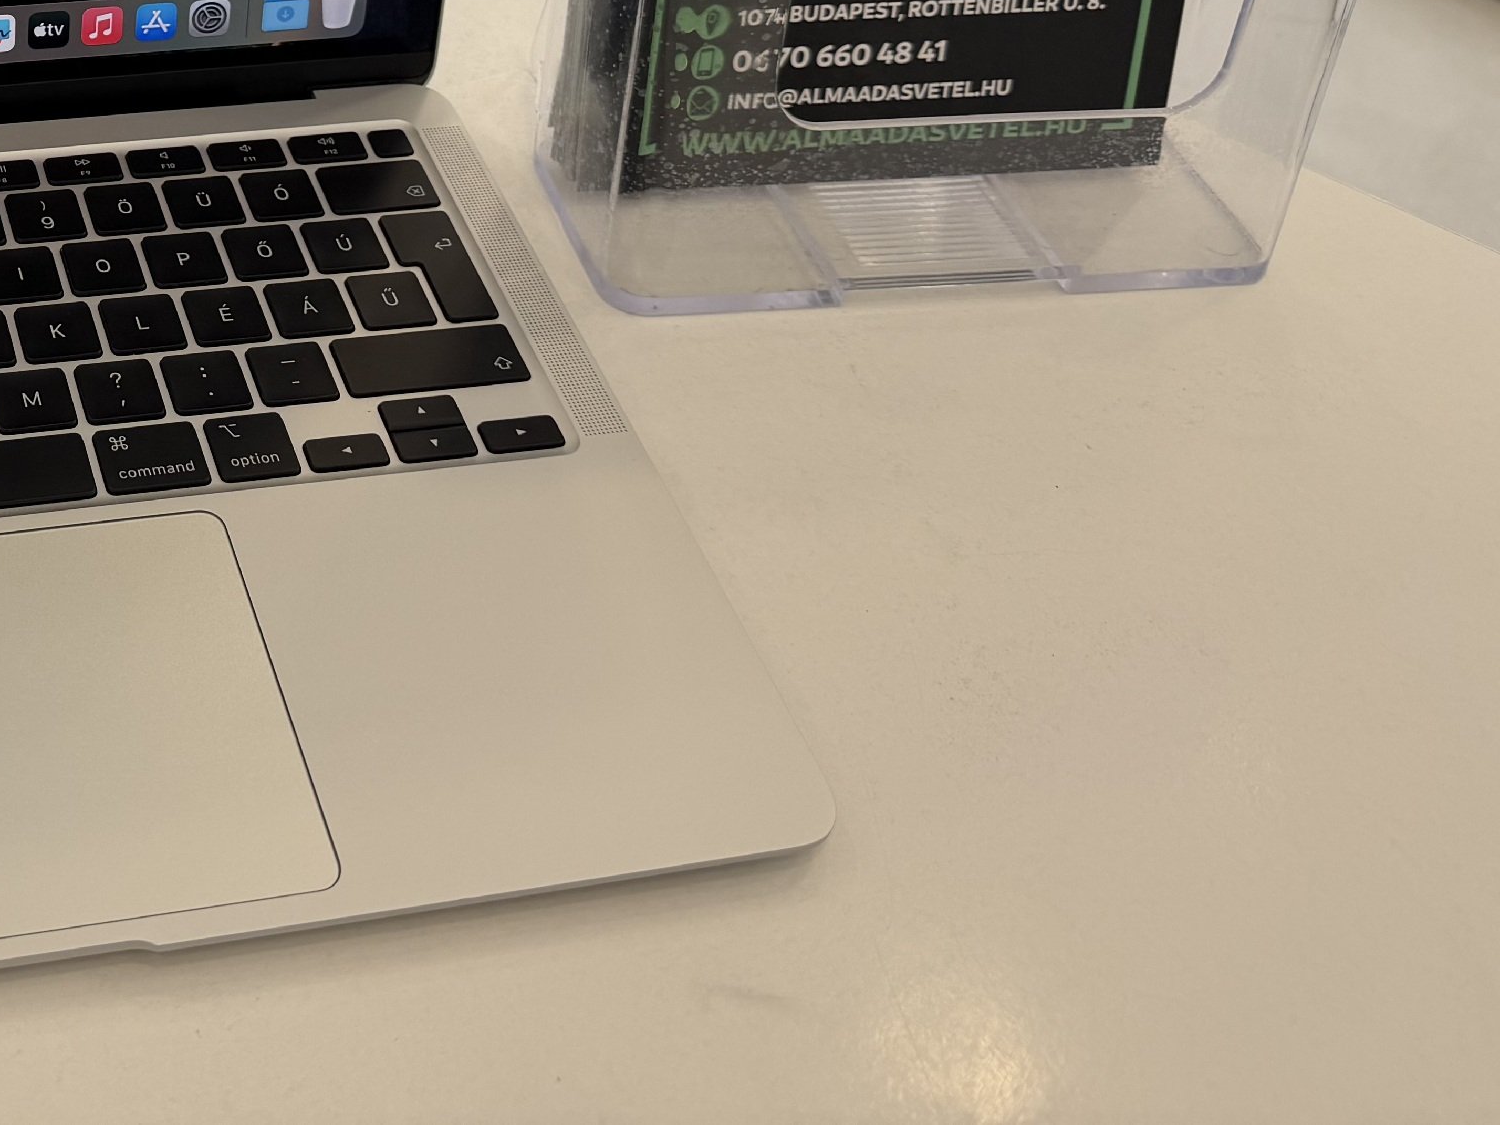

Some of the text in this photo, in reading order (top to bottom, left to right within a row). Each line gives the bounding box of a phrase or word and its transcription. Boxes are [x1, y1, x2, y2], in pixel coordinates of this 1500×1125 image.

[789, 1, 906, 24] BUDAPEST,
[816, 43, 872, 67] 660
[876, 41, 912, 65] 48
[917, 39, 948, 64] 41
[195, 191, 212, 207] Ü
[273, 183, 289, 201] Ó
[117, 198, 133, 214] Ö
[40, 216, 55, 229] 9
[335, 233, 353, 252] Ú
[95, 258, 111, 273] O
[176, 252, 190, 266] P
[218, 303, 234, 322] É
[303, 295, 319, 315] Á
[49, 323, 66, 339] K
[135, 316, 150, 330] L
[21, 390, 42, 408] M
[230, 452, 280, 468] option
[118, 459, 196, 479] command
